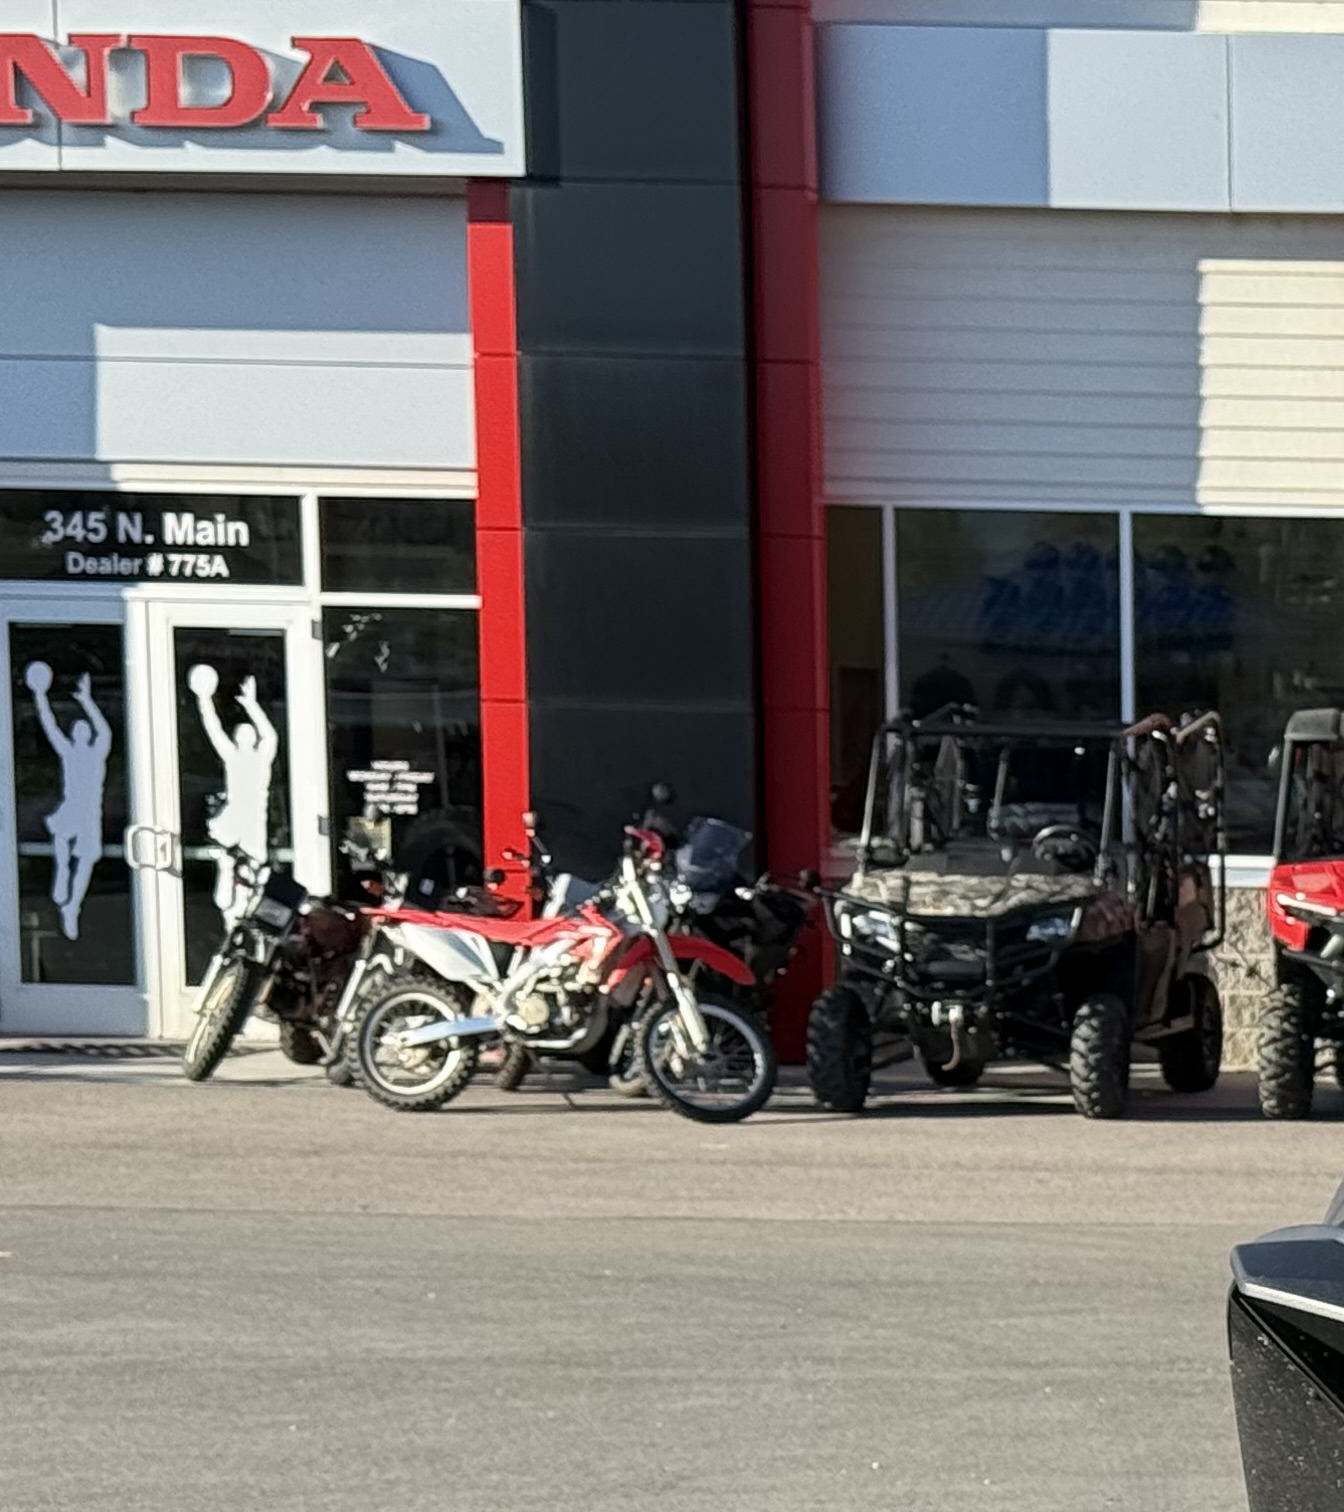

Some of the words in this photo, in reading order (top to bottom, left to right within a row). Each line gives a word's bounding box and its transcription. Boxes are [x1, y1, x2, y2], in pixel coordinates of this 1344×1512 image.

[42, 510, 107, 544] 345
[117, 511, 155, 545] N.
[161, 511, 249, 547] Main
[66, 552, 142, 575] Dealer
